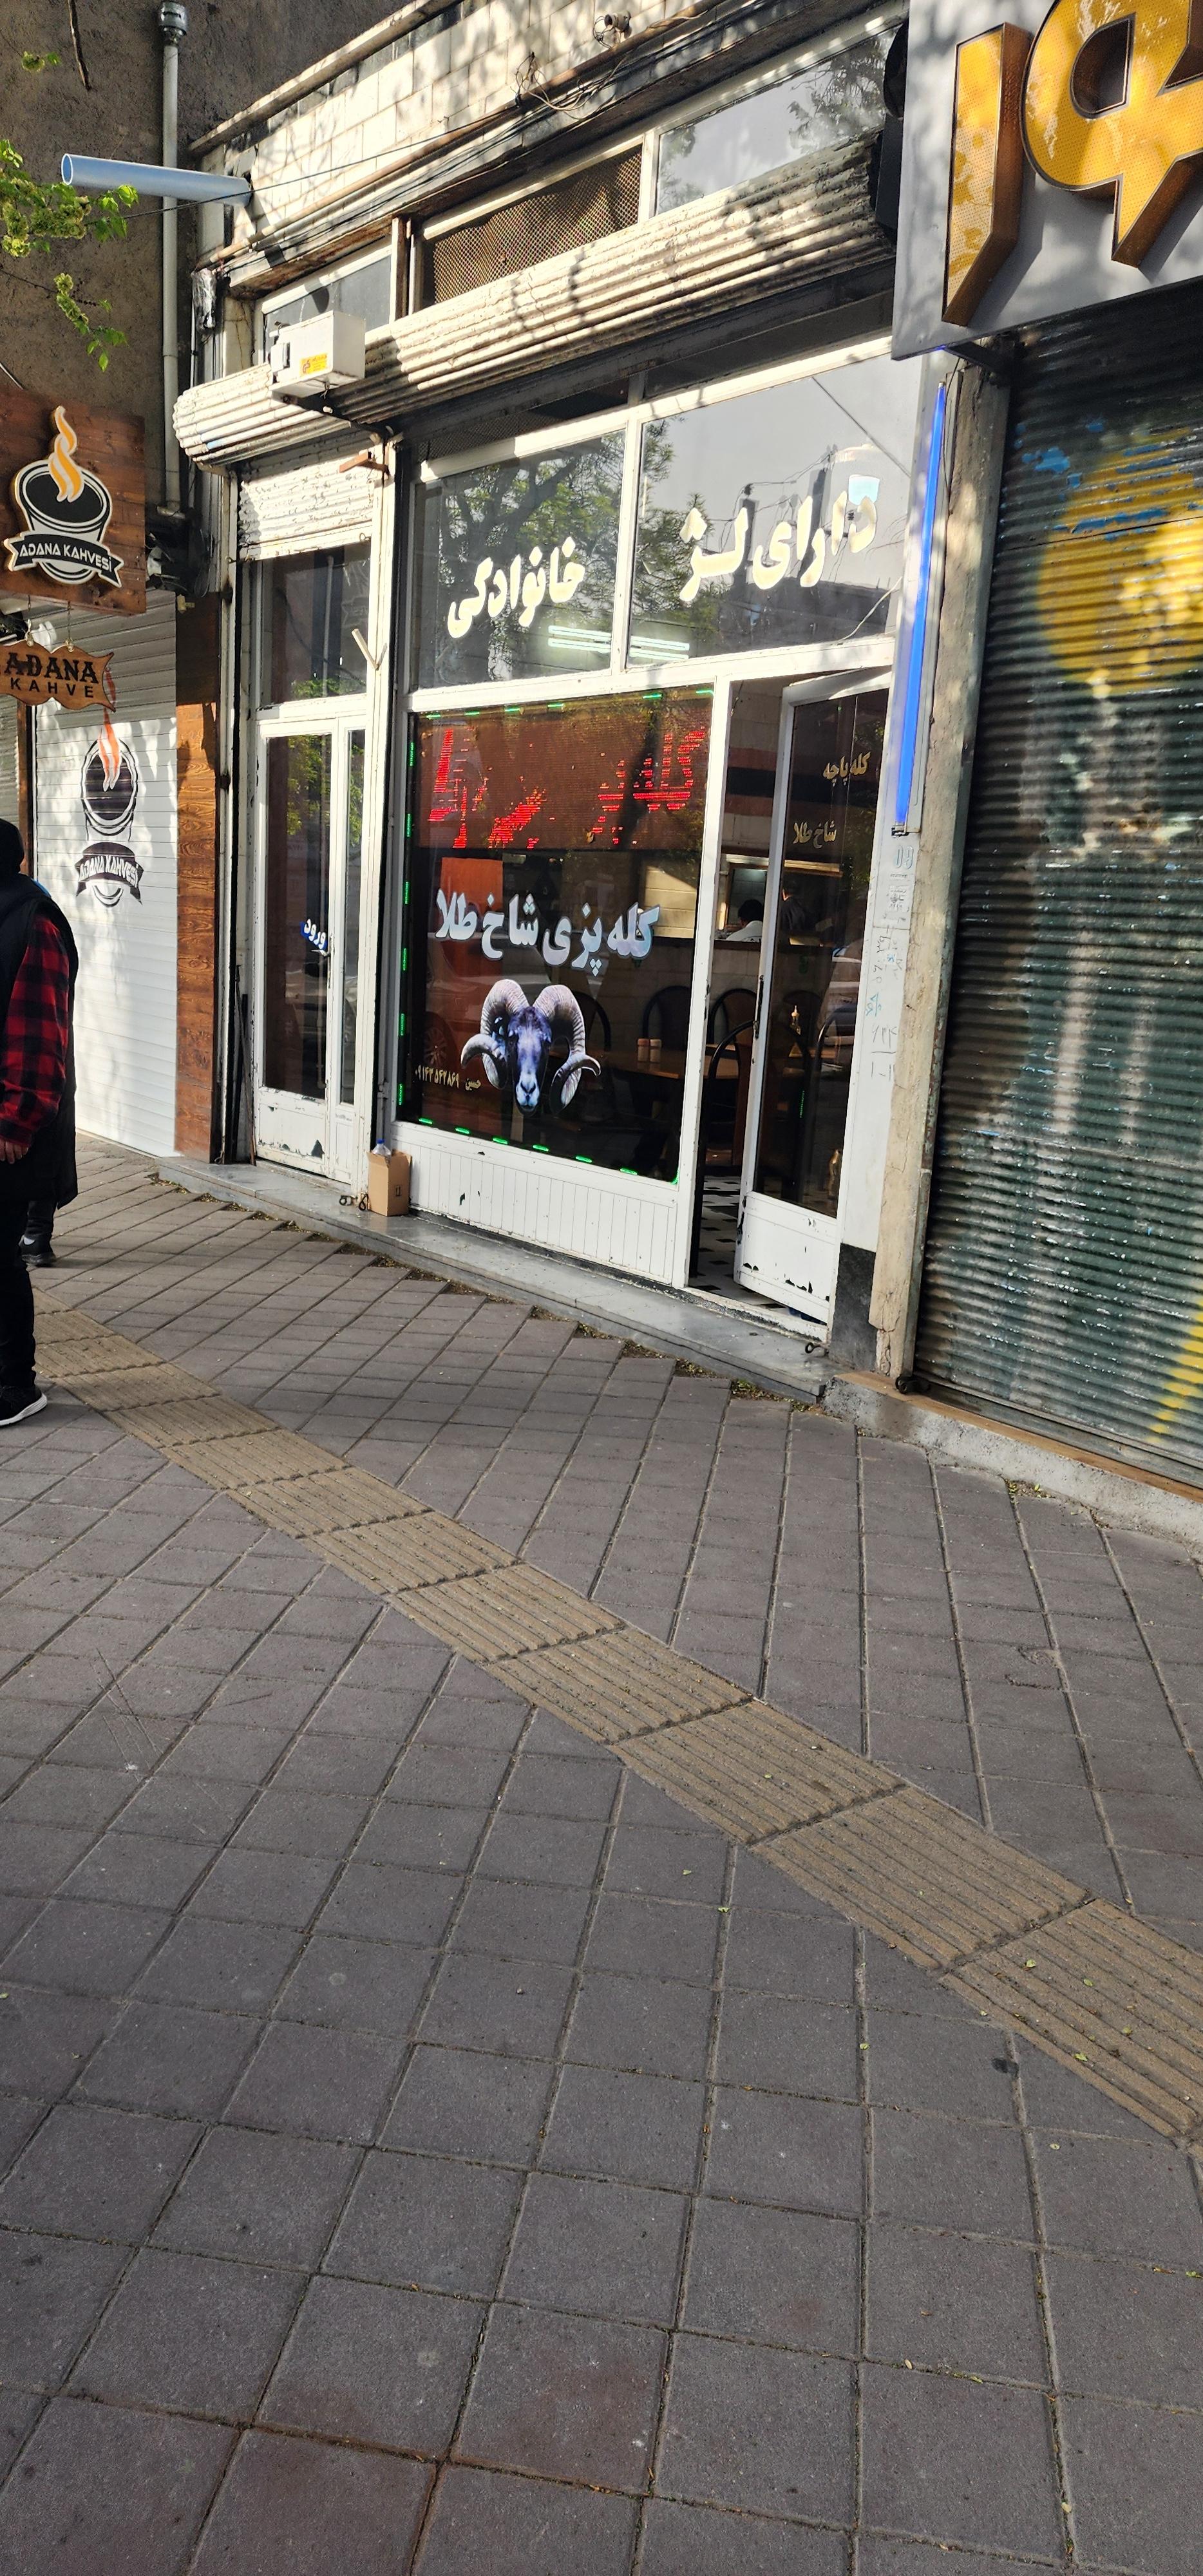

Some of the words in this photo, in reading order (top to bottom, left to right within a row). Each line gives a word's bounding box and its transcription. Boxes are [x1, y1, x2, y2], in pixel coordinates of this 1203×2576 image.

[679, 507, 749, 601] لژ
[752, 491, 877, 590] دارای
[19, 543, 61, 557] ADANA
[63, 544, 113, 573] KAHVESİ
[4, 652, 99, 685] ADANA
[10, 677, 94, 699] KAHVE
[822, 755, 849, 788] پاچه
[849, 752, 871, 776] کله
[793, 822, 813, 844] طلا
[813, 820, 837, 849] شاخ
[435, 888, 478, 941] طلا
[481, 892, 540, 960] شاخ
[607, 901, 661, 958] کله
[303, 918, 327, 950] ورود
[542, 902, 603, 978] پزی
